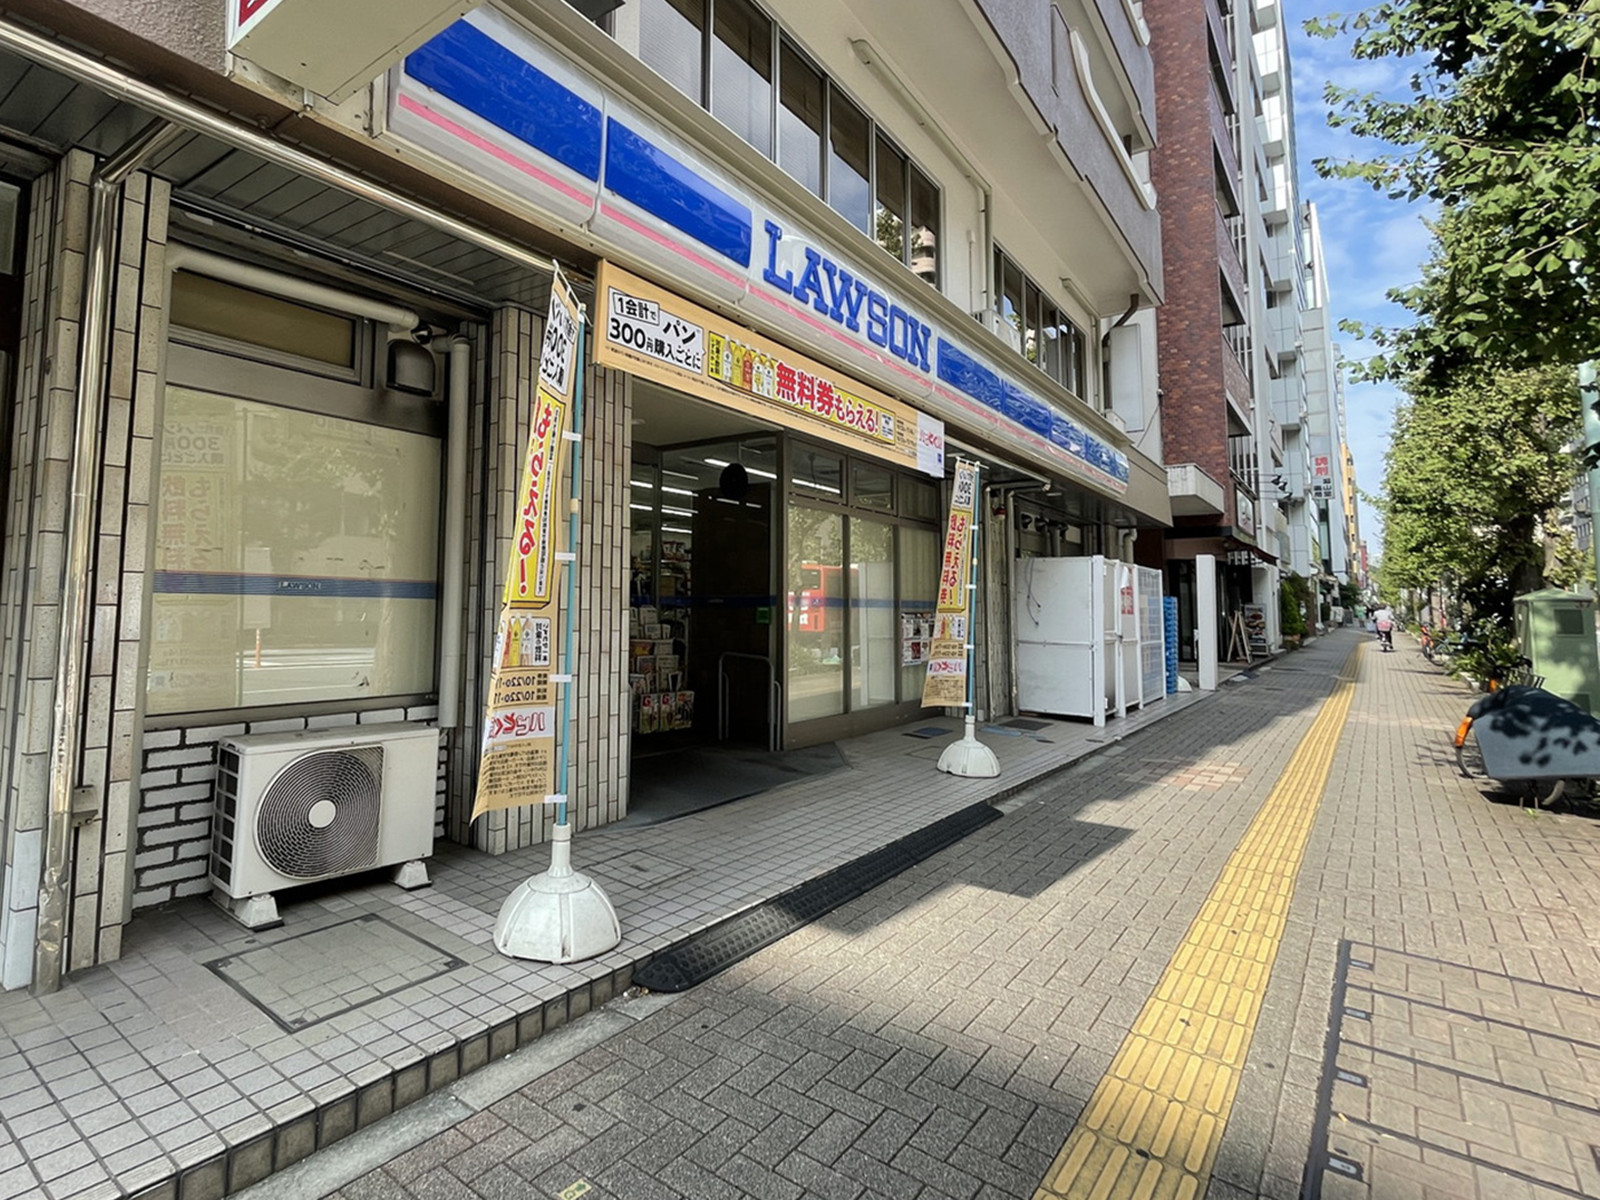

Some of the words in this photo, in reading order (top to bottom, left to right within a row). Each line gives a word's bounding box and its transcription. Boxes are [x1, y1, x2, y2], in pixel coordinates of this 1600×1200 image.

[617, 297, 657, 321] 1会計で
[763, 219, 932, 373] LAWSON
[609, 317, 701, 370] 300円購入ごとに
[662, 320, 696, 344] パン
